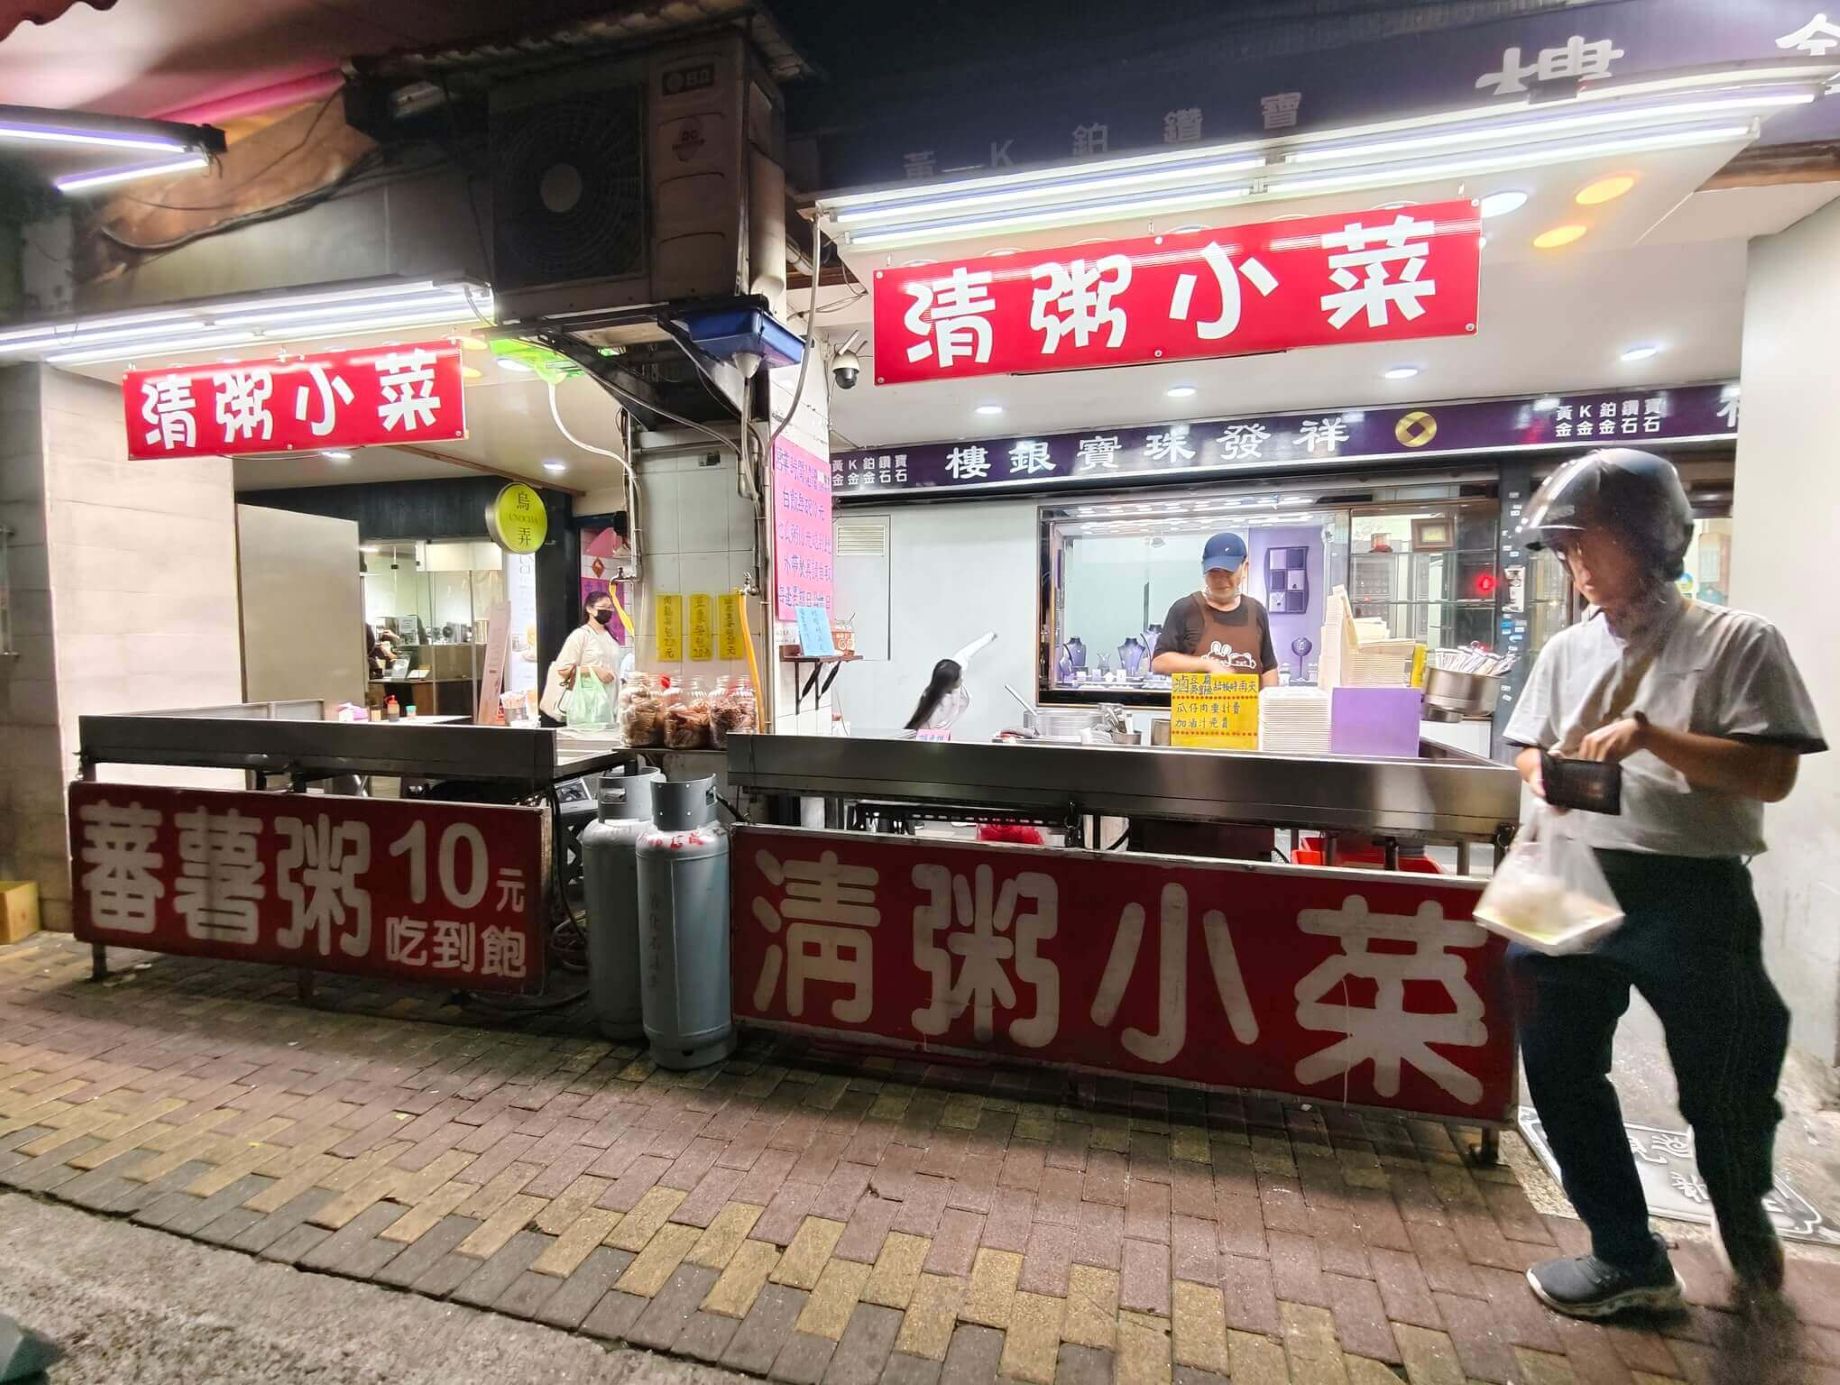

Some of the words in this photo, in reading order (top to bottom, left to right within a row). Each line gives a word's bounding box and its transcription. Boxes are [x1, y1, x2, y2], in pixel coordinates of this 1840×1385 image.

[904, 214, 1437, 369] 清粥小菜
[141, 349, 442, 451] 清粥小菜
[79, 799, 372, 957] 蕃薯粥
[385, 915, 527, 979] 吃到飽
[752, 849, 1490, 1105] 清粥小菜
